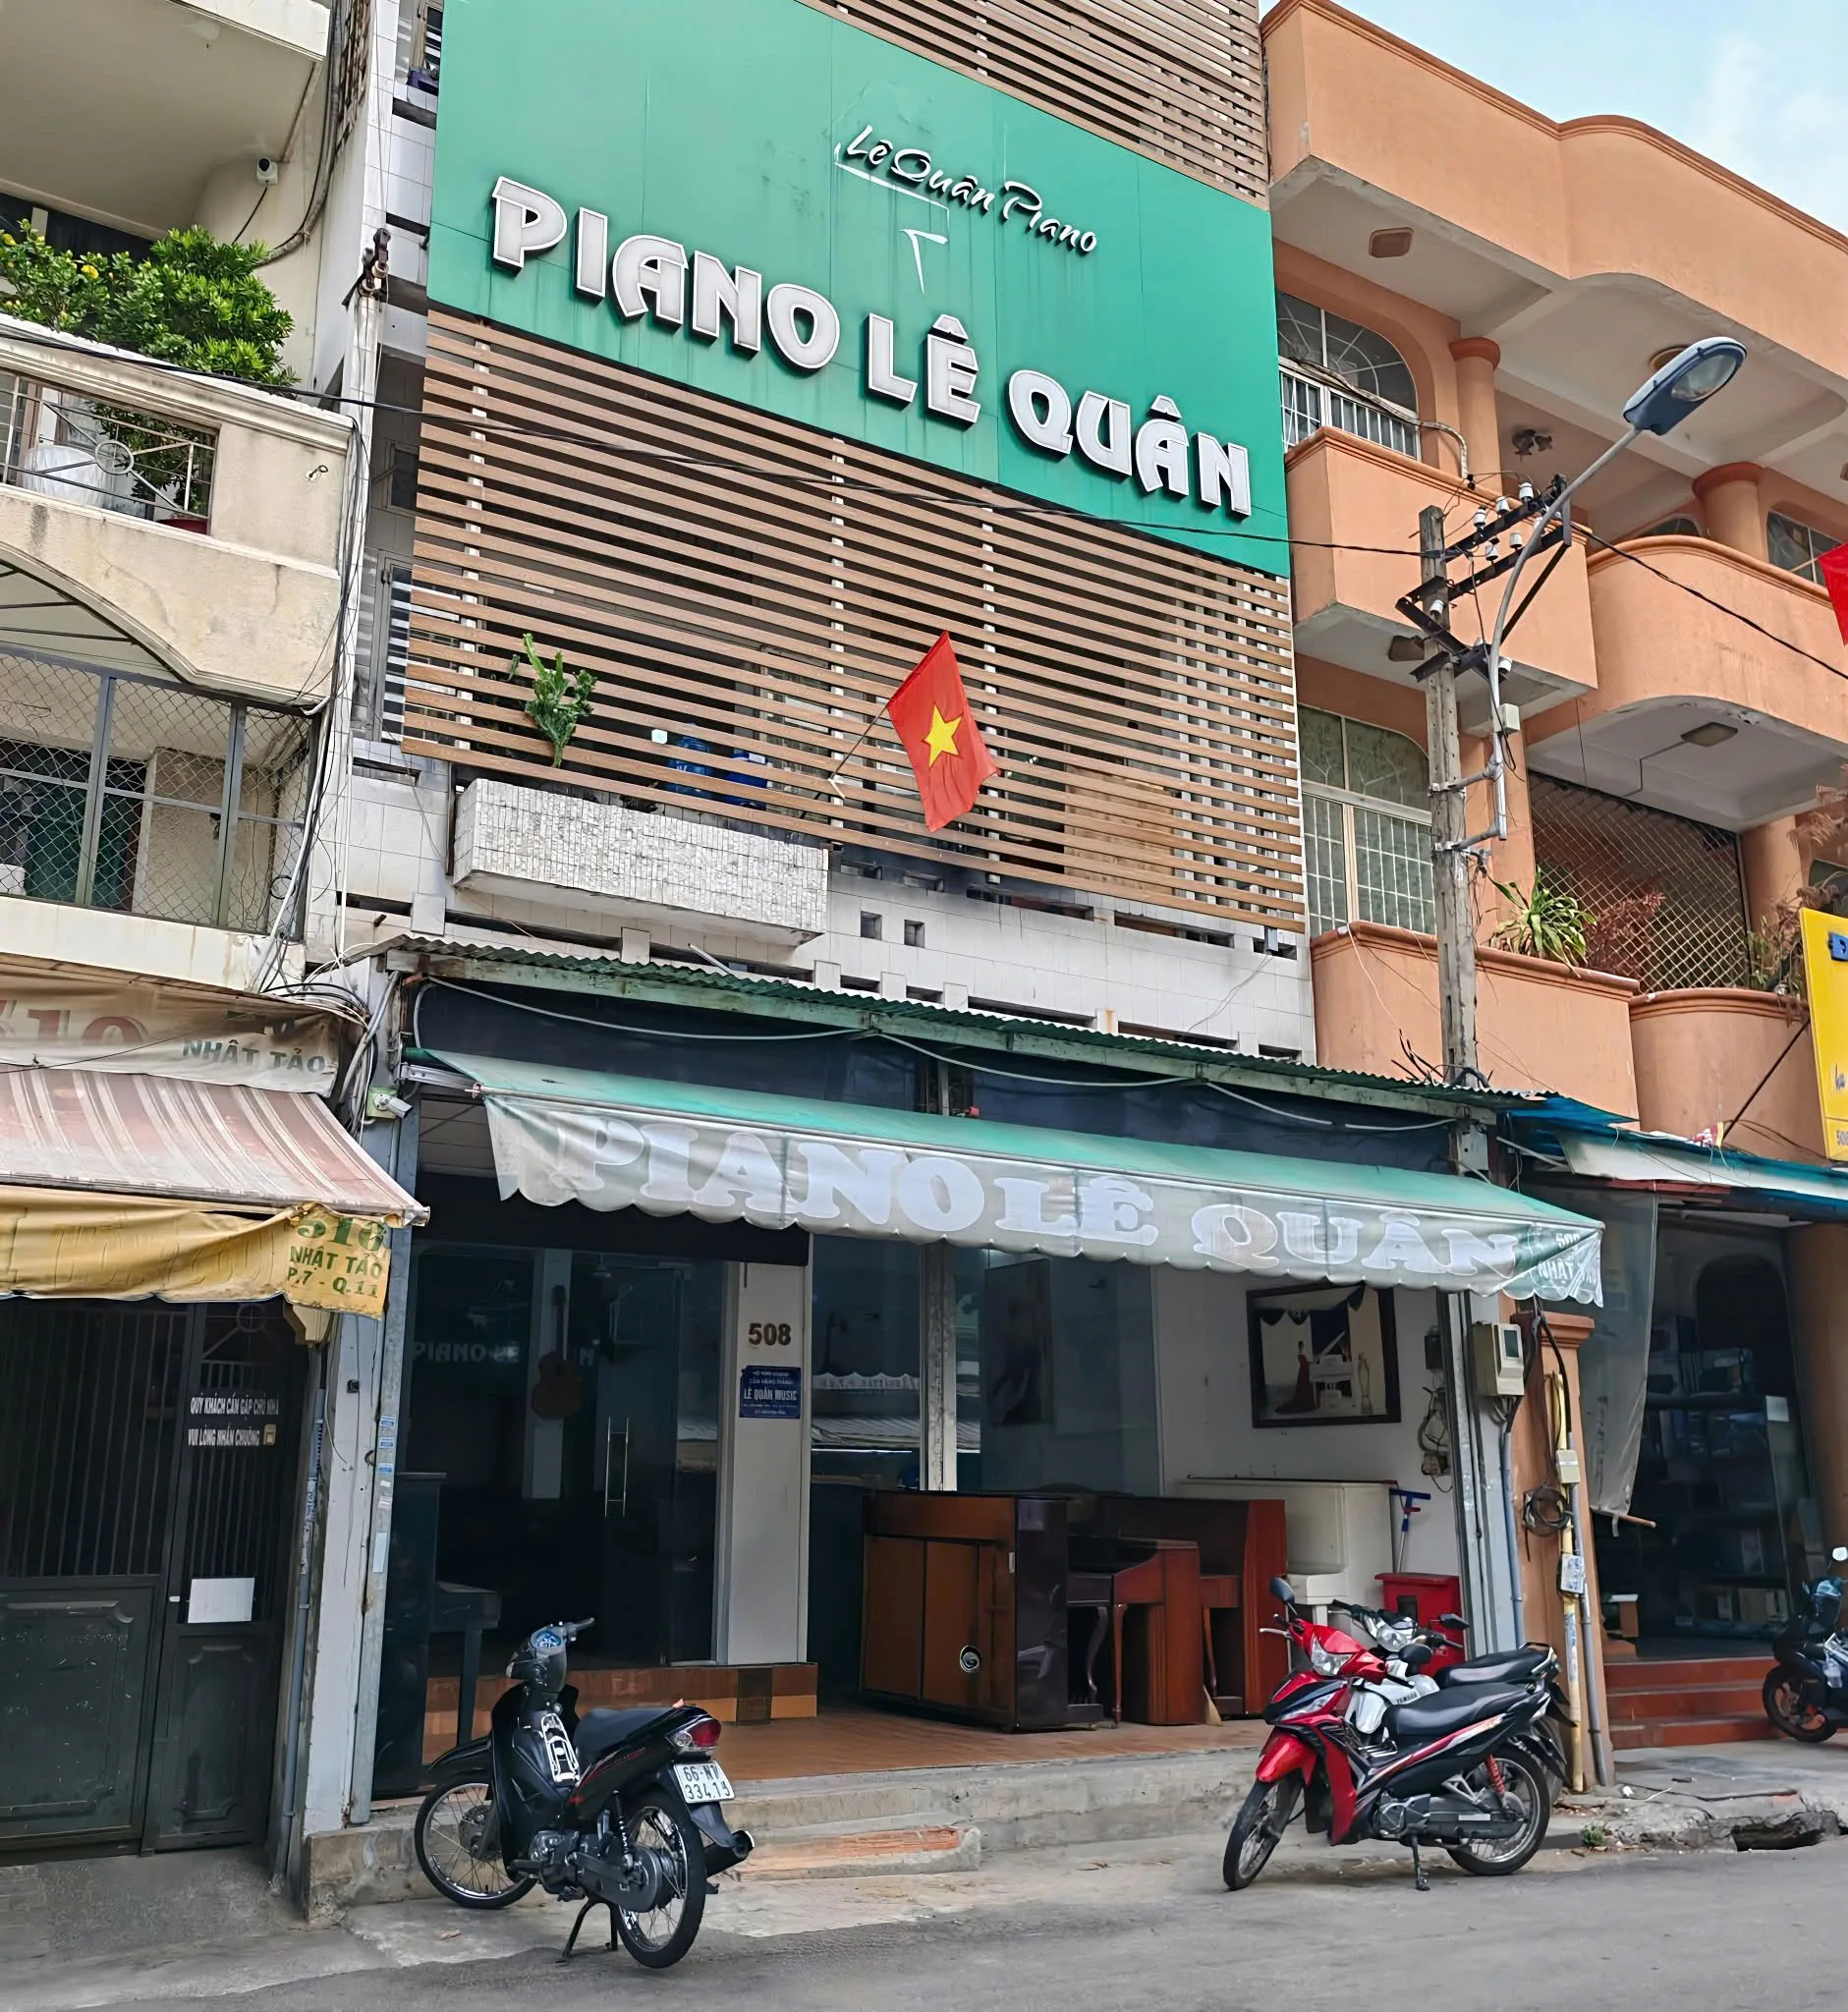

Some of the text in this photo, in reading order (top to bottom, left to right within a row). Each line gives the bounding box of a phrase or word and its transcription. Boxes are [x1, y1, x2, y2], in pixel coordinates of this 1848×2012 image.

[1002, 180, 1098, 253] Piano
[491, 175, 1254, 518] PIANO LÊ QUÂN
[269, 1047, 326, 1074] TẢO
[544, 1111, 1519, 1279] PIANO LÊ QUÂN
[290, 1245, 383, 1279] NHẬT TẢO
[748, 1322, 792, 1346] 508
[774, 1388, 798, 1401] MUSIC
